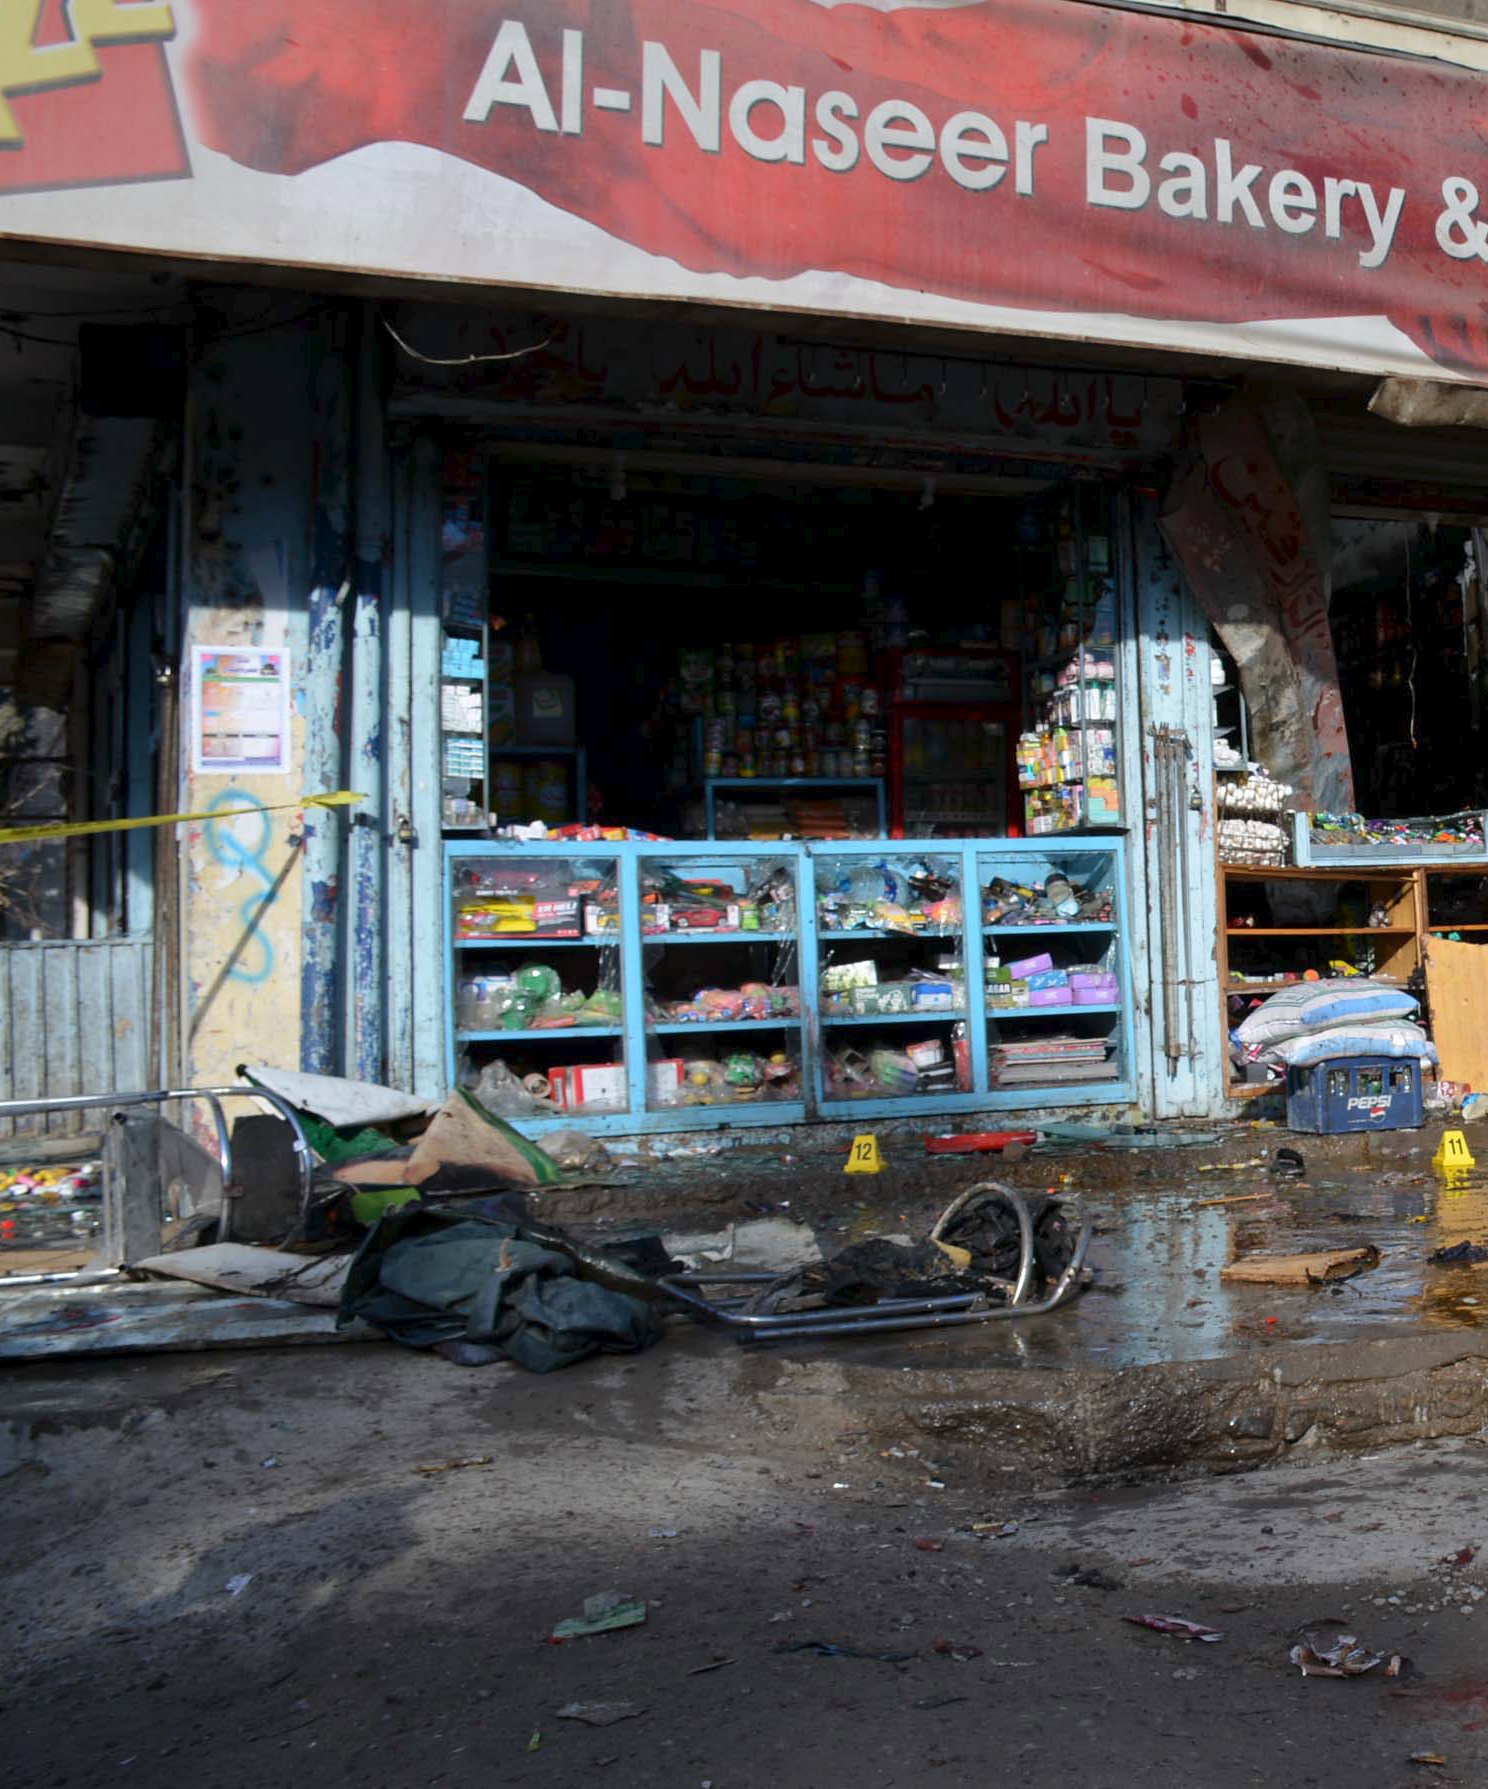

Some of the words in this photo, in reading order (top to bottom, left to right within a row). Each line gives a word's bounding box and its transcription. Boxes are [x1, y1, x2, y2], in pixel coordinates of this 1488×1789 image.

[462, 19, 1048, 197] Al-Naseer
[1085, 117, 1405, 267] Bakery
[1347, 1095, 1392, 1110] PEPSI
[855, 1142, 872, 1160] 12
[1448, 1138, 1464, 1155] 11
